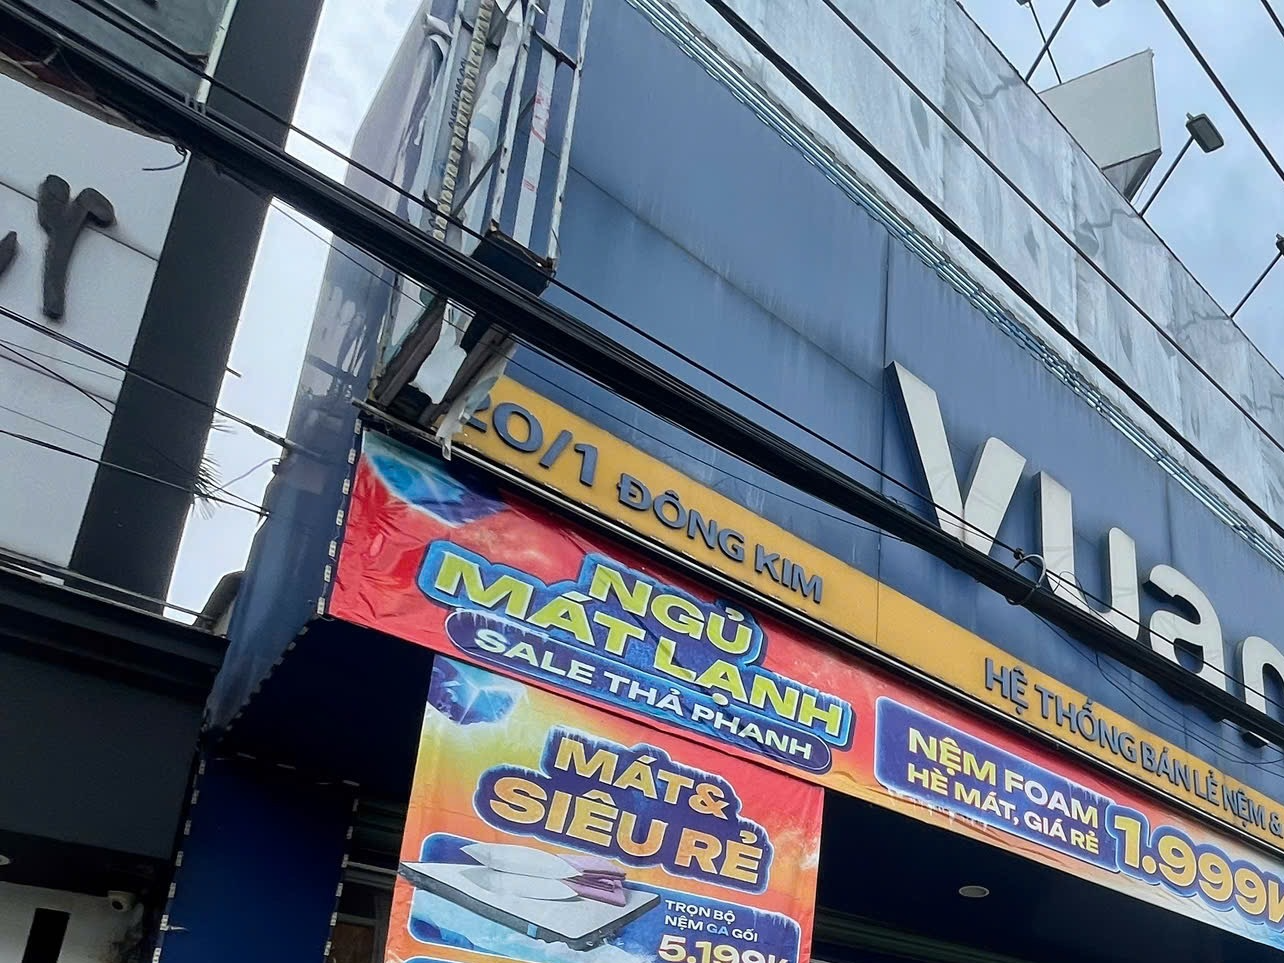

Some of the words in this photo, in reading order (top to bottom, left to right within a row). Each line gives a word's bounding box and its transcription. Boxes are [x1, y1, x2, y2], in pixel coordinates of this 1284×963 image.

[589, 562, 754, 656] NGỦ
[755, 544, 823, 604] KIM
[434, 549, 646, 657] MÁT
[653, 636, 844, 738] LẠNH
[474, 627, 594, 686] SALE
[603, 670, 683, 716] THẢ
[691, 703, 812, 761] PHANH
[908, 727, 997, 786] NỆM
[1004, 768, 1098, 829] FOAM
[985, 657, 1028, 715] HỆ
[1034, 696, 1137, 763] THỐNG
[1140, 741, 1191, 792] BÁN
[1193, 769, 1219, 806] LẺ
[1222, 784, 1266, 830] NỆM
[1269, 811, 1284, 839] &
[490, 776, 669, 857] SIÊU
[674, 827, 763, 885] RẺ
[907, 762, 949, 796] HÈ
[954, 781, 1019, 826] MÁT,
[1023, 811, 1068, 842] GIÁ
[1070, 827, 1100, 855] RẺ
[664, 915, 703, 931] NỆM
[706, 924, 729, 937] GA
[732, 928, 758, 943] GỐI
[665, 899, 711, 918] TRỌN
[714, 909, 736, 925] BỘ
